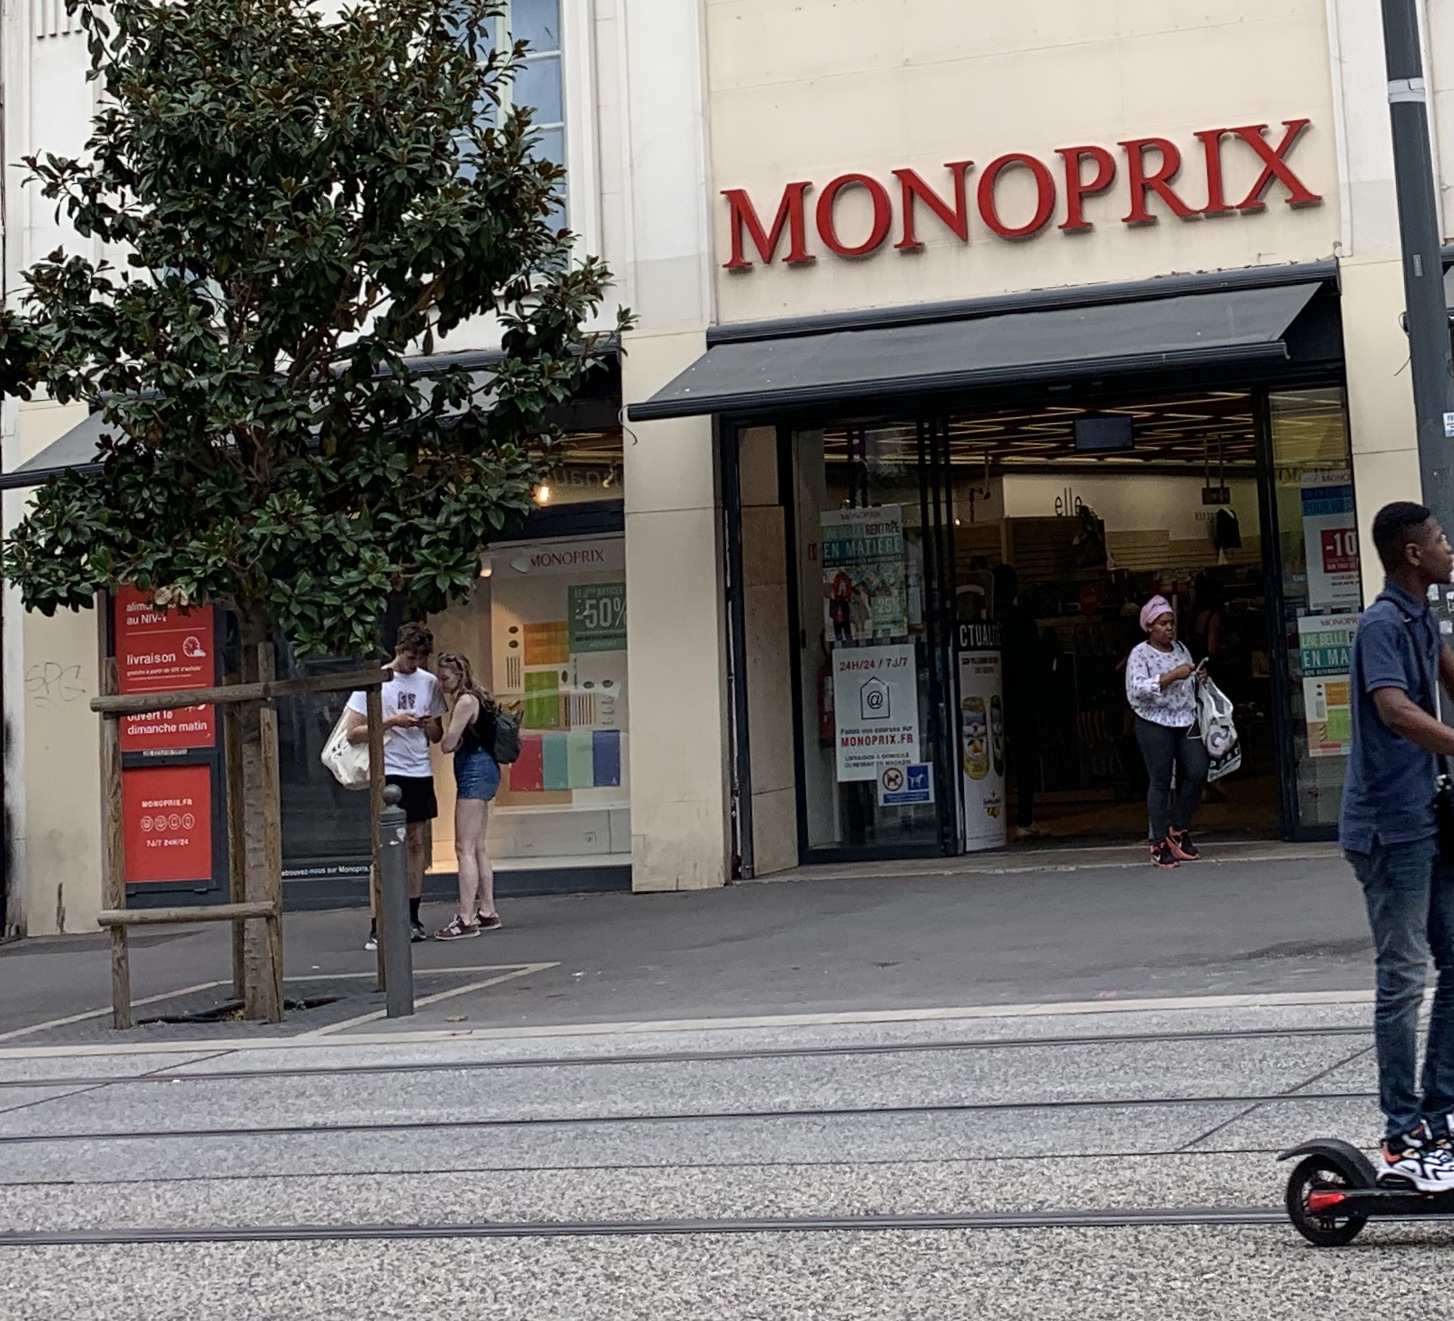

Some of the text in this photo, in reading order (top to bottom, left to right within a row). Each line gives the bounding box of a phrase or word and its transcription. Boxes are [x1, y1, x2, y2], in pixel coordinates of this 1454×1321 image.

[720, 118, 1324, 271] MONOPRIX
[824, 542, 839, 558] EN
[1326, 531, 1357, 557] -10
[531, 549, 605, 567] MONOPRIX
[127, 616, 139, 625] au
[1320, 631, 1344, 646] BELLE
[127, 652, 176, 665] livraison
[840, 660, 875, 671] 24H/24
[886, 657, 908, 667] 7J/7
[1303, 650, 1320, 667] EN
[163, 710, 173, 719] le
[128, 721, 207, 735] dimanche matin
[841, 734, 913, 747] MONOPRIX.FR
[281, 868, 325, 876] etrouvez-nous
